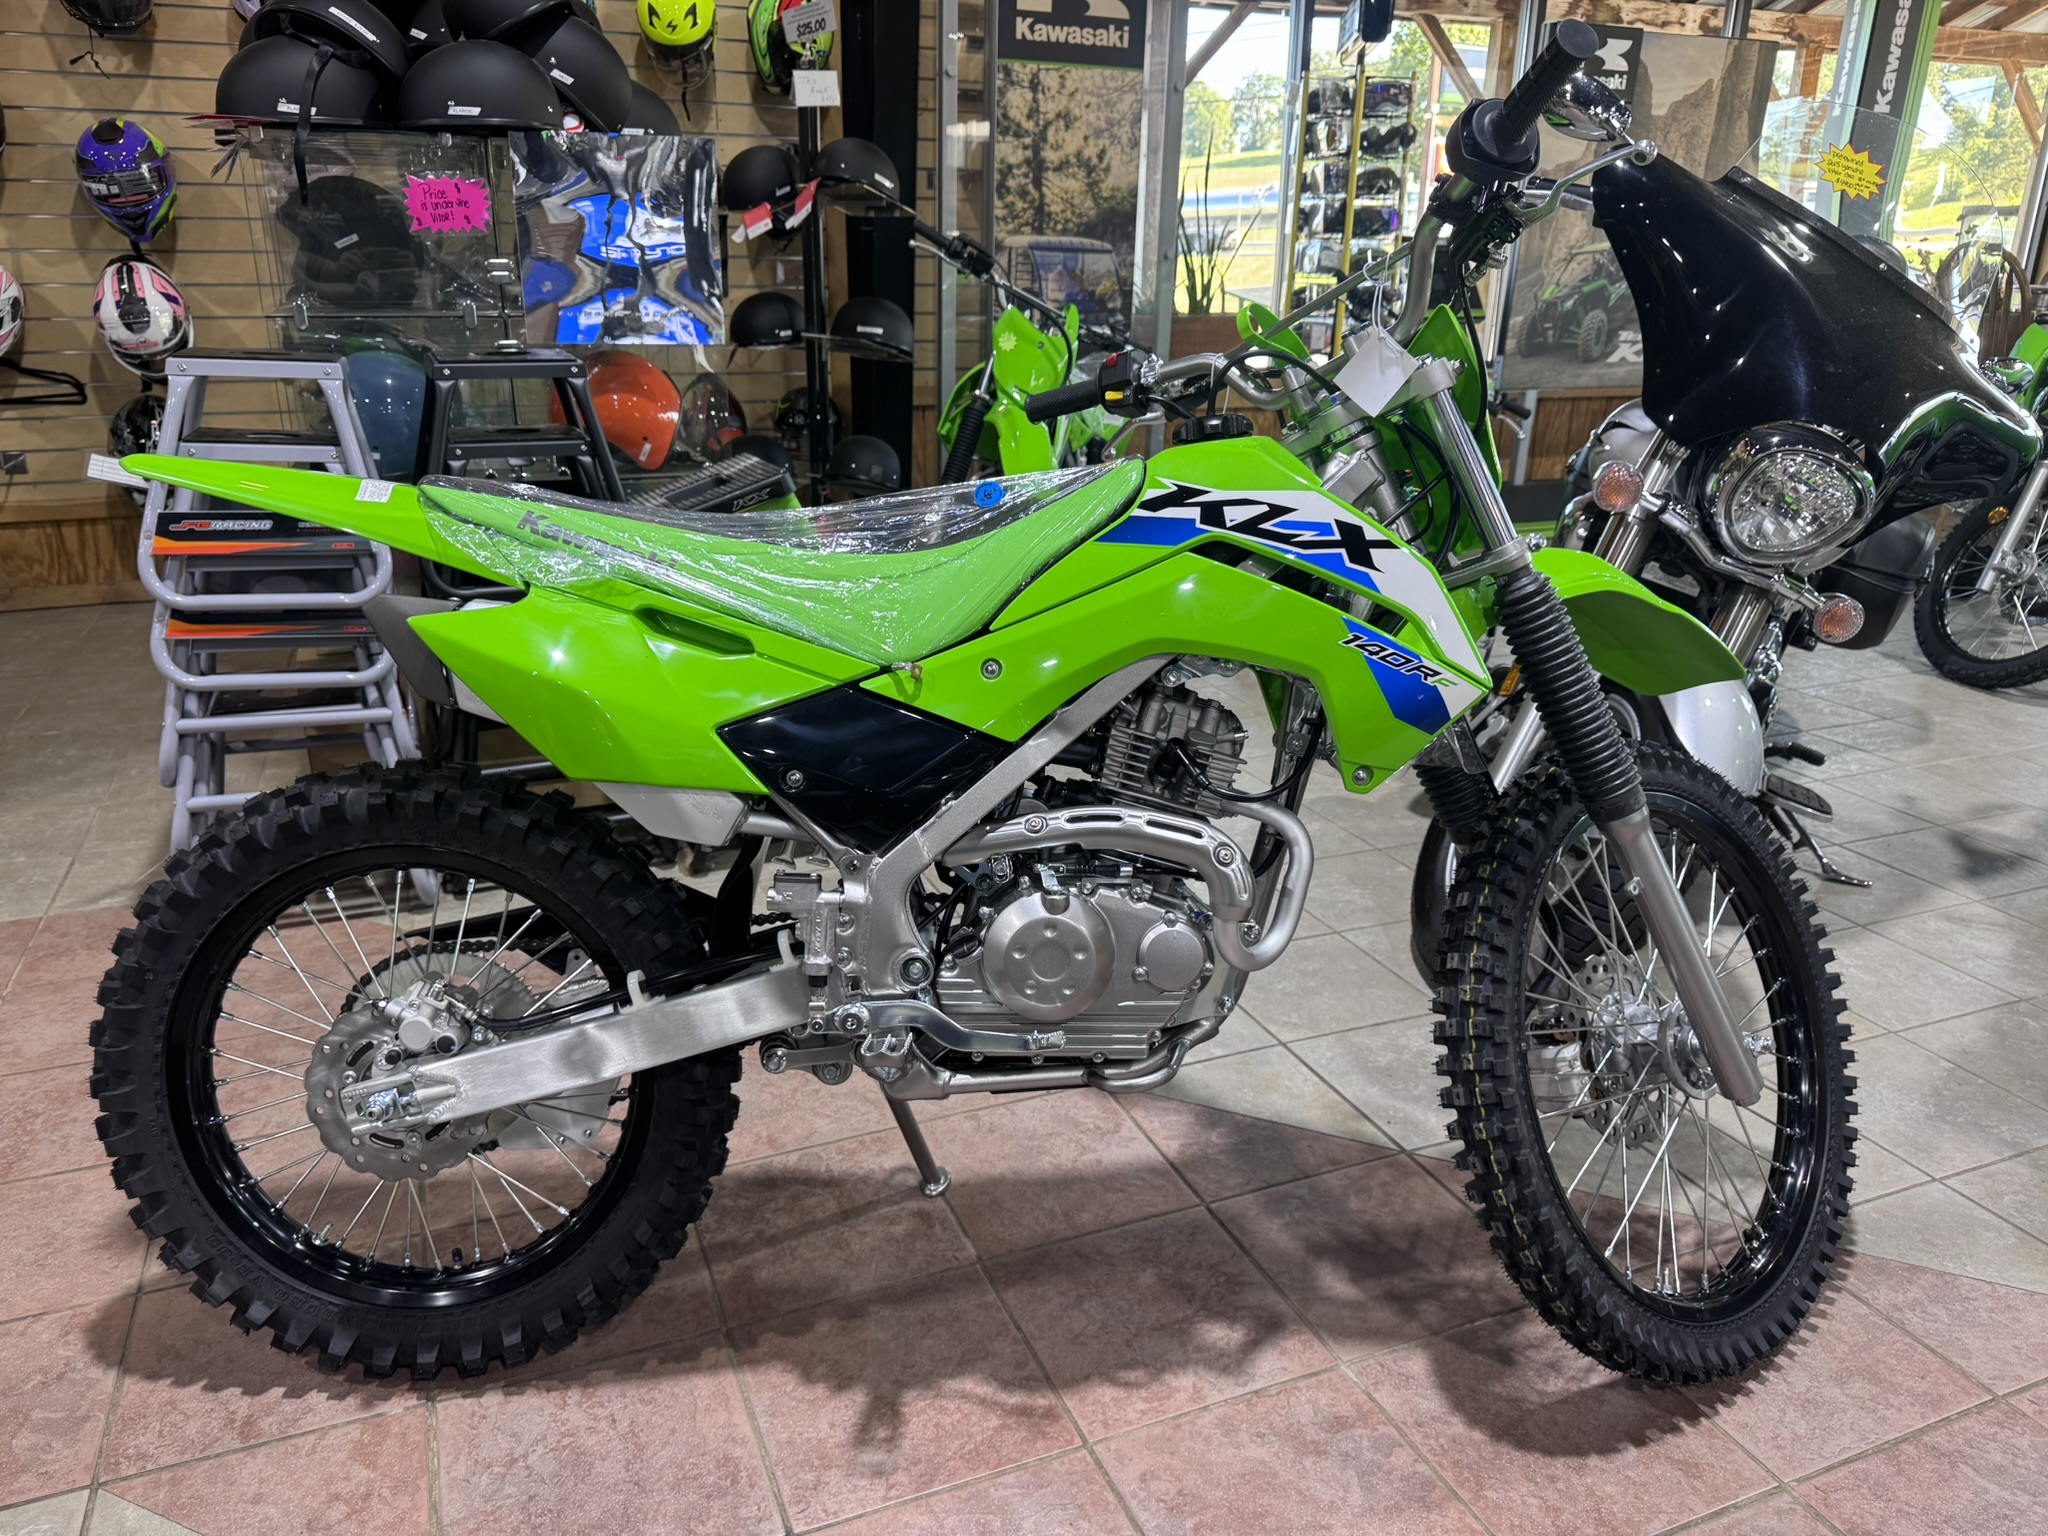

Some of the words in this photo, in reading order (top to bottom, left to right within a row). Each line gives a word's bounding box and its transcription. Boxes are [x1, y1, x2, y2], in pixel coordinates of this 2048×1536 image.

[796, 17, 826, 39] $25.00
[1015, 16, 1130, 48] Kawasaki
[418, 183, 448, 200] Price
[420, 200, 428, 211] is
[431, 200, 454, 211] under
[455, 197, 471, 209] the
[1137, 482, 1400, 574] KLX
